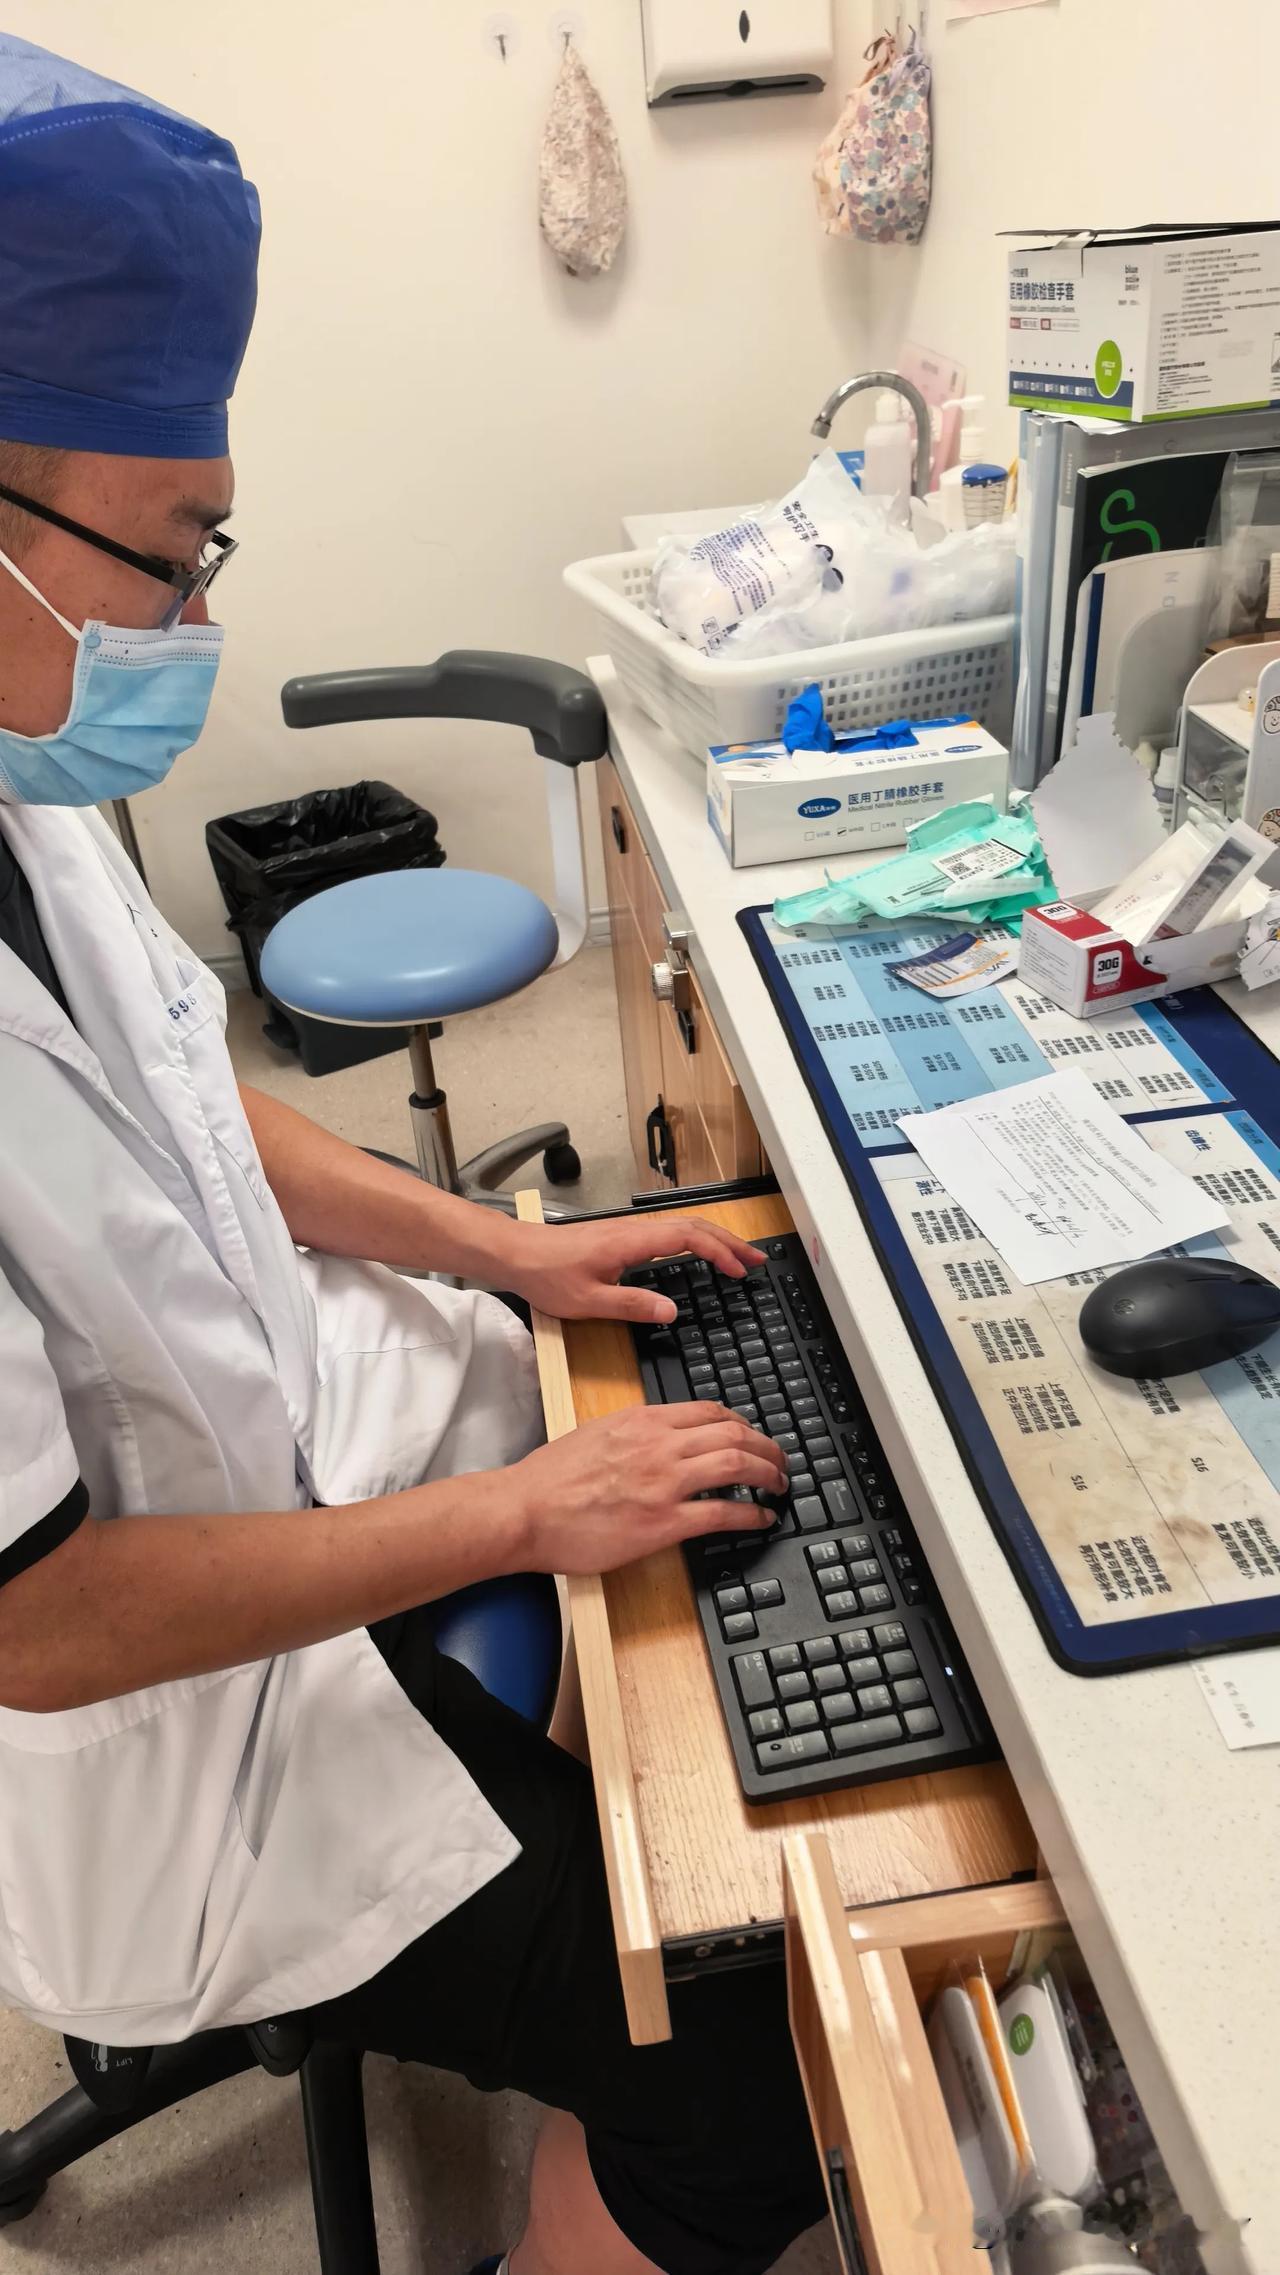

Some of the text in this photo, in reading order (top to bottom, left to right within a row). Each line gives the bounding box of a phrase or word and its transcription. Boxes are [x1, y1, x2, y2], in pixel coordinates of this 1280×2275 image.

[1010, 282, 1074, 300] 医用橡胶检查手套
[848, 782, 944, 805] 医用丁腈橡胶手套
[848, 804, 873, 813] Medical
[1098, 956, 1119, 972] 30G
[168, 992, 197, 1021] 598
[982, 1258, 1012, 1295] 上颌发育不足
[1047, 1381, 1082, 1427] 上颌不足加重
[1094, 1540, 1138, 1600] 复发可能较大
[1128, 1535, 1174, 1593] 近效相对肯定
